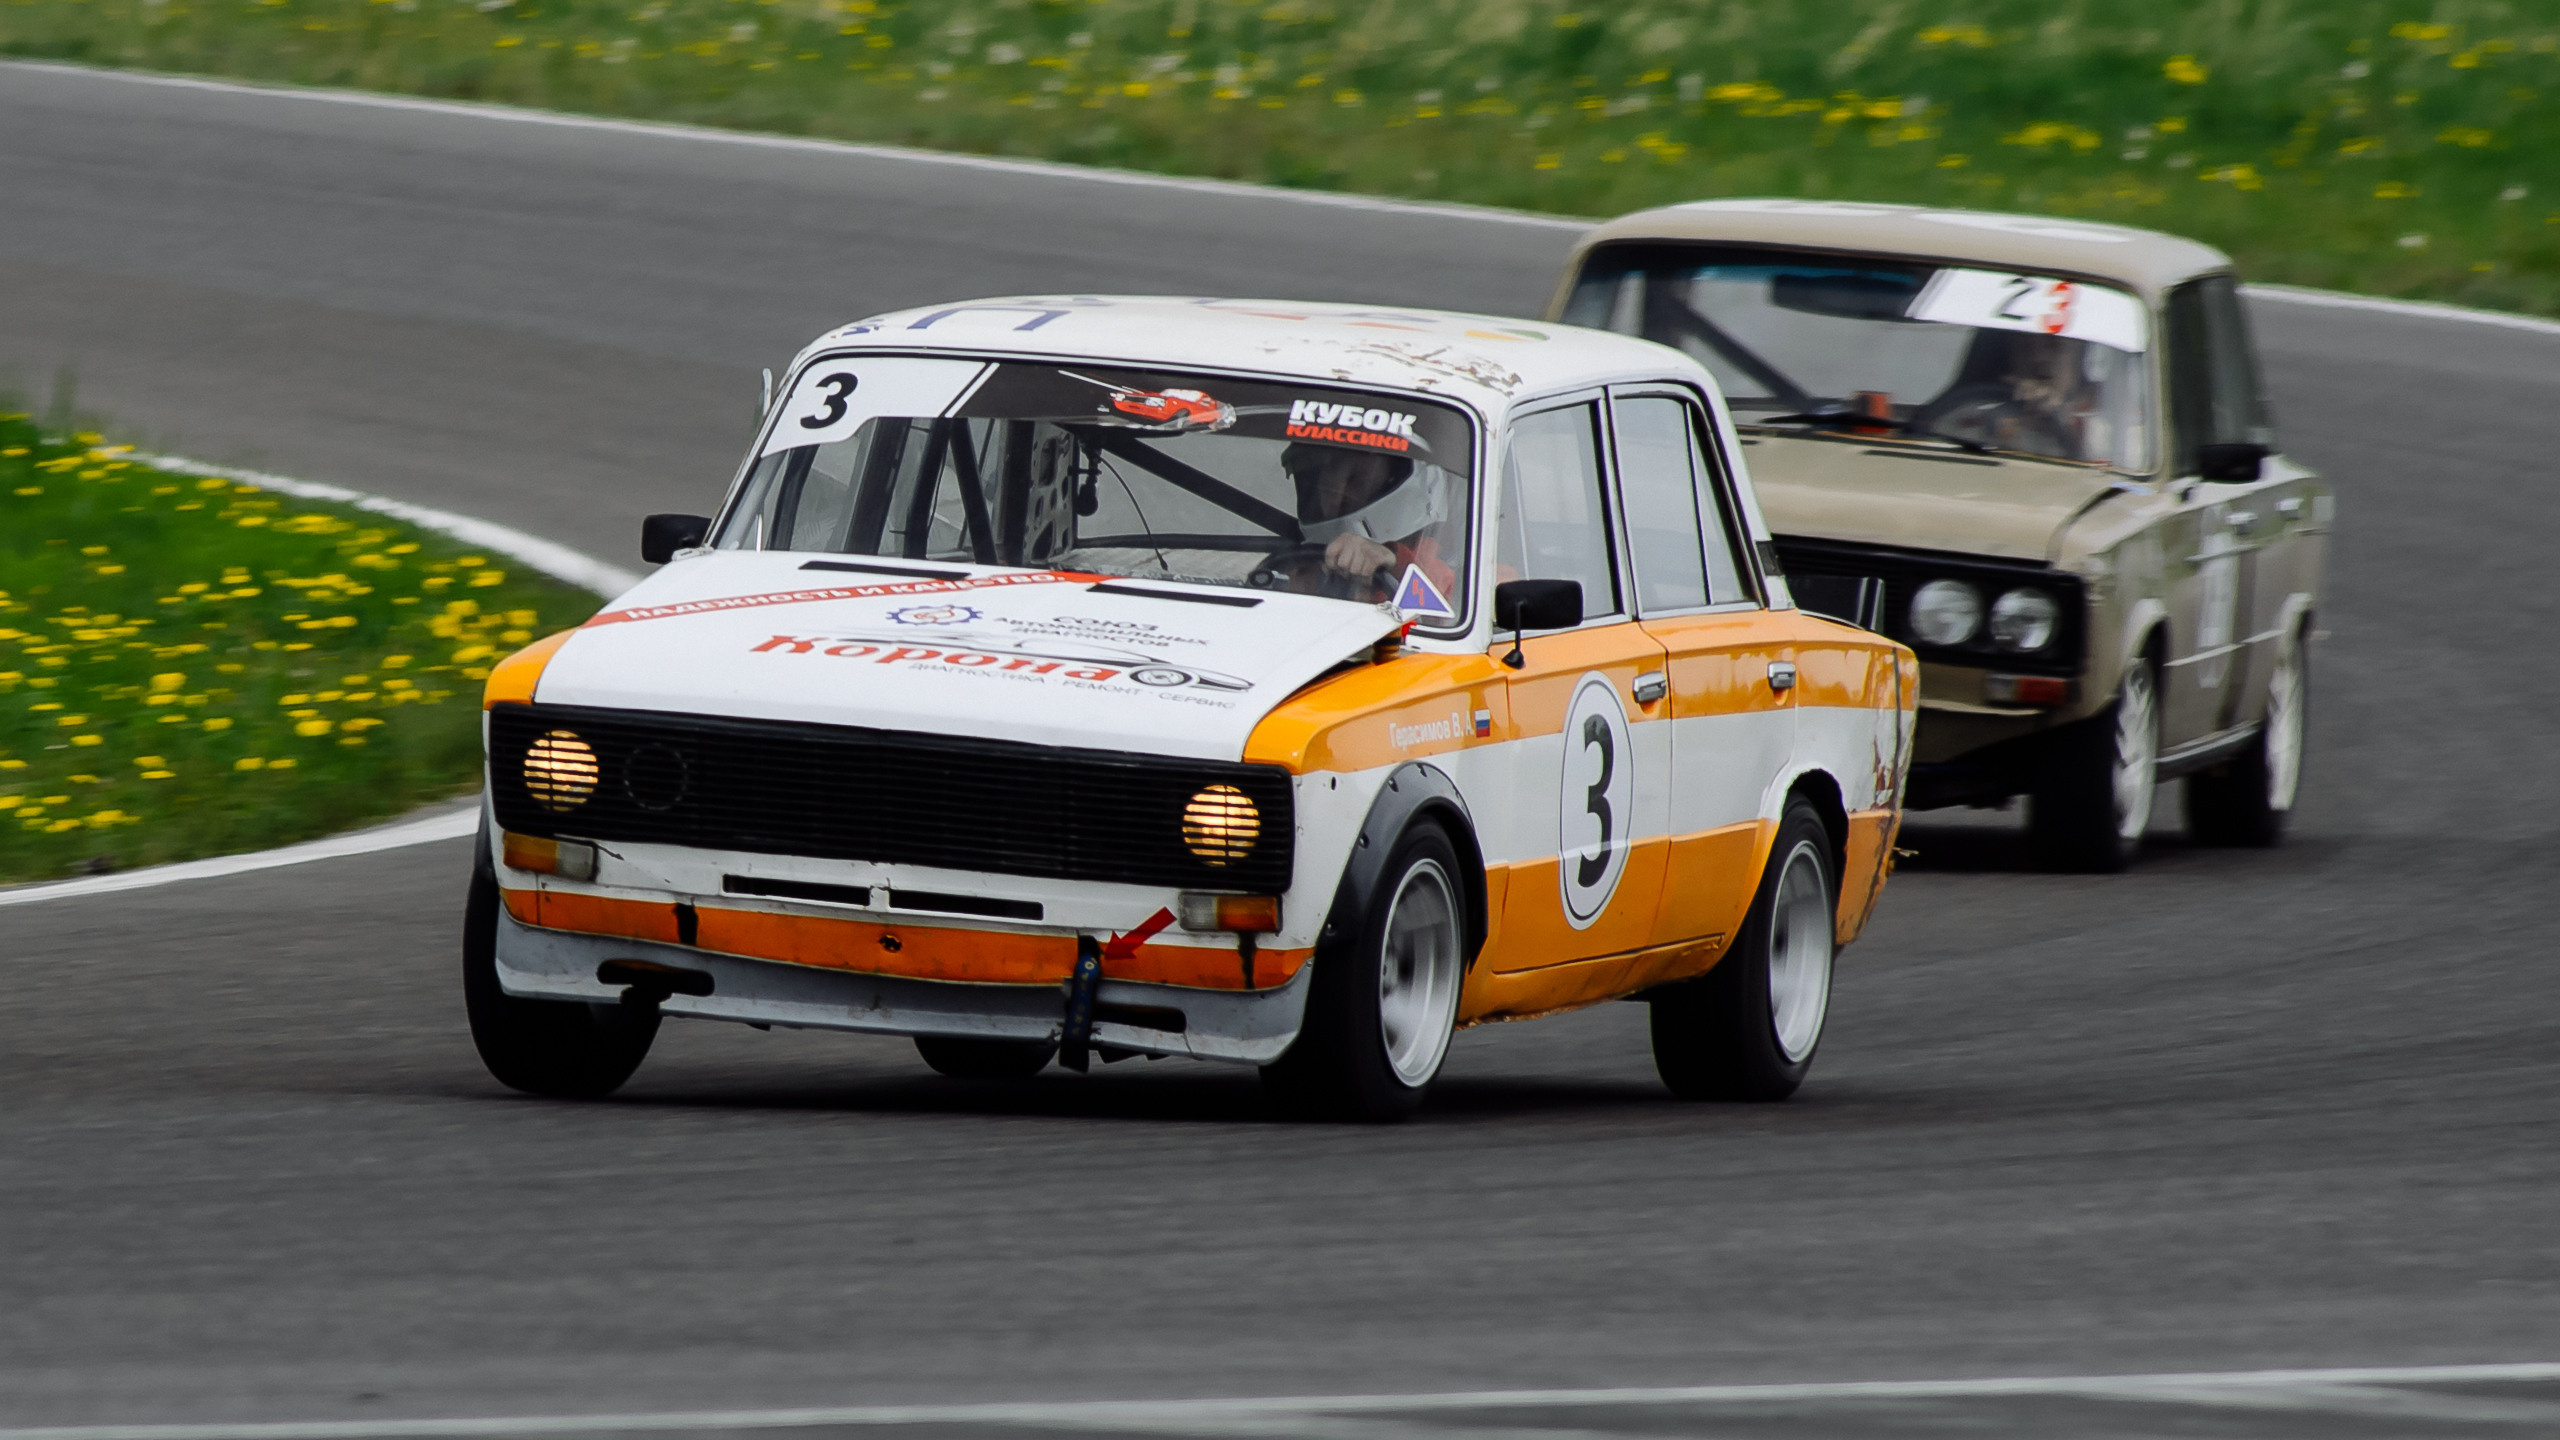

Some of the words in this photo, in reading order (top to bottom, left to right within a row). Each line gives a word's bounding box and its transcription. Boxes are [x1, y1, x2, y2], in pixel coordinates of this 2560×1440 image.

[1994, 278, 2076, 334] 23
[800, 372, 858, 429] 3
[1289, 400, 1417, 436] КУБОК
[1286, 424, 1409, 452] КЛАССИКИ
[626, 589, 850, 619] НАДЕЖНОСТЬ
[857, 587, 882, 595] И
[1053, 616, 1158, 631] СОЮЗ
[750, 634, 1121, 681] Корона
[1062, 679, 1140, 697] РЕМОНТ
[1158, 692, 1236, 711] СЕРВИС
[1389, 720, 1451, 752] Герасимов
[1577, 713, 1615, 889] 3
